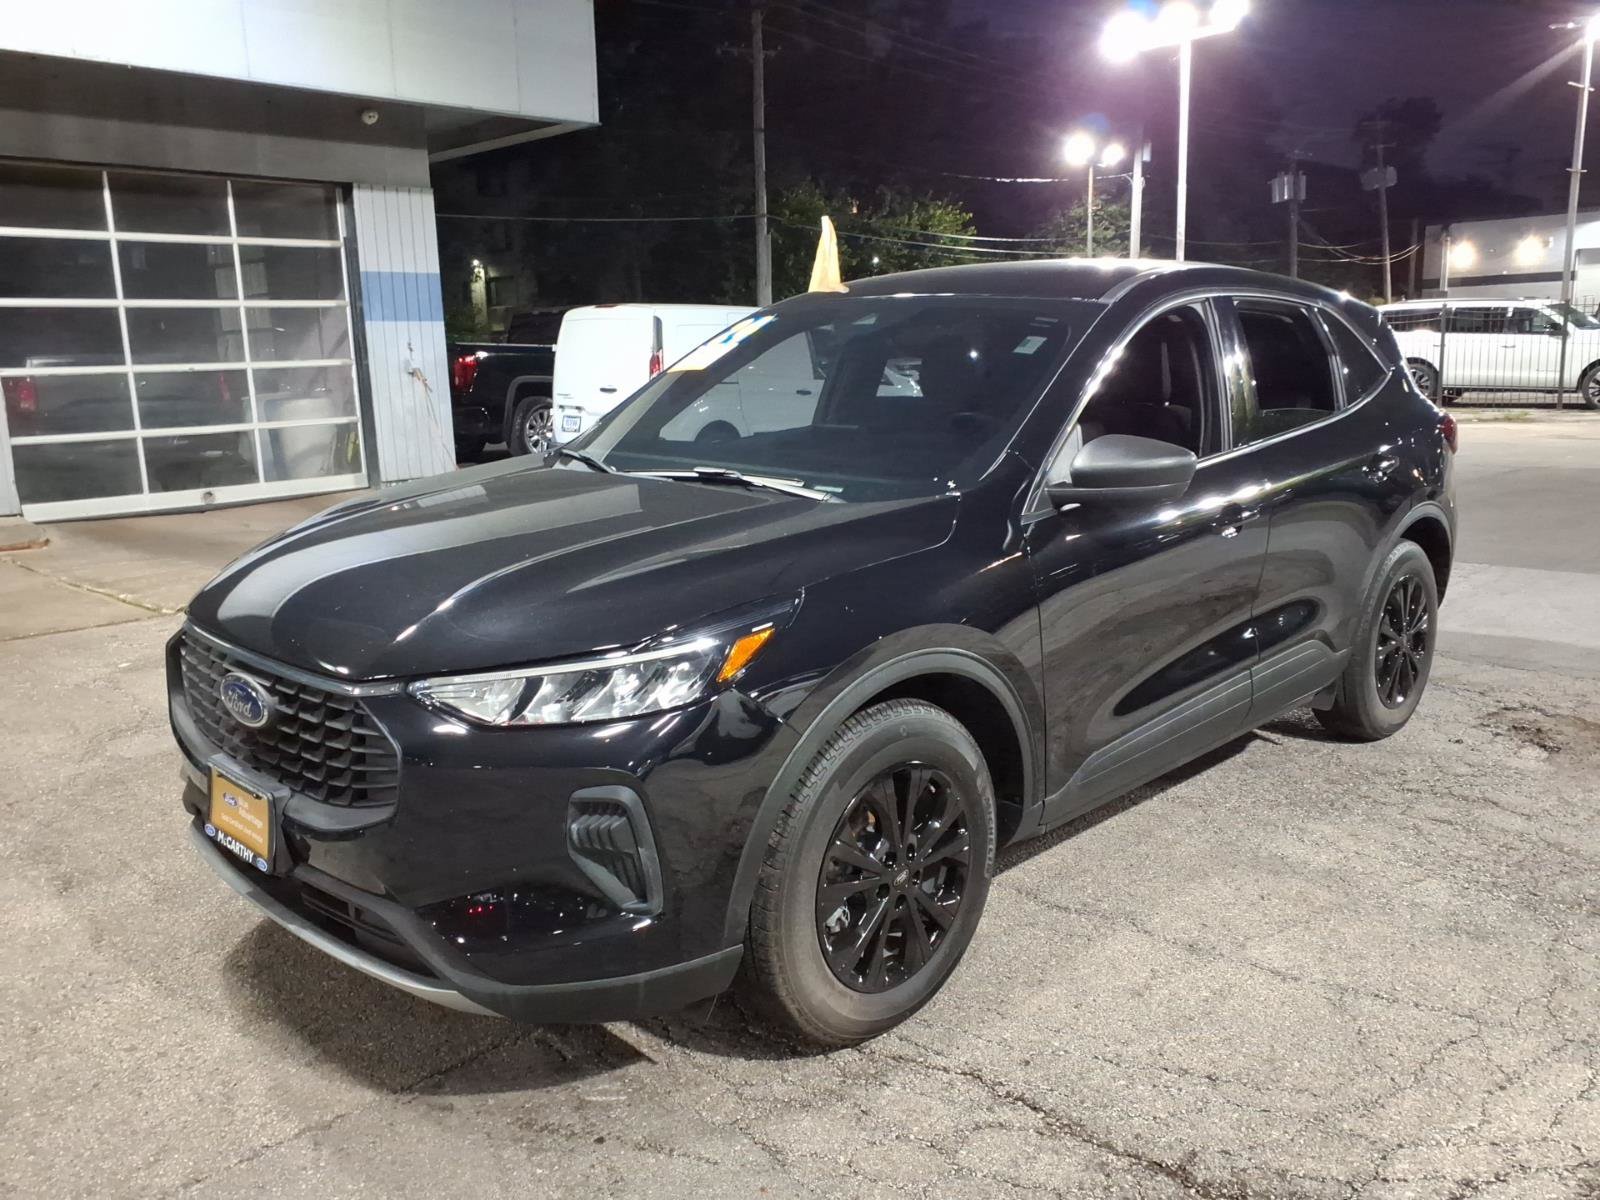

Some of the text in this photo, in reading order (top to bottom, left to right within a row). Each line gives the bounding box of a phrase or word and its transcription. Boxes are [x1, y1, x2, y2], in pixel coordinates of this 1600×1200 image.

[225, 686, 252, 718] Ford
[217, 830, 254, 863] McCARTHY
[982, 796, 994, 875] MICHELIN
